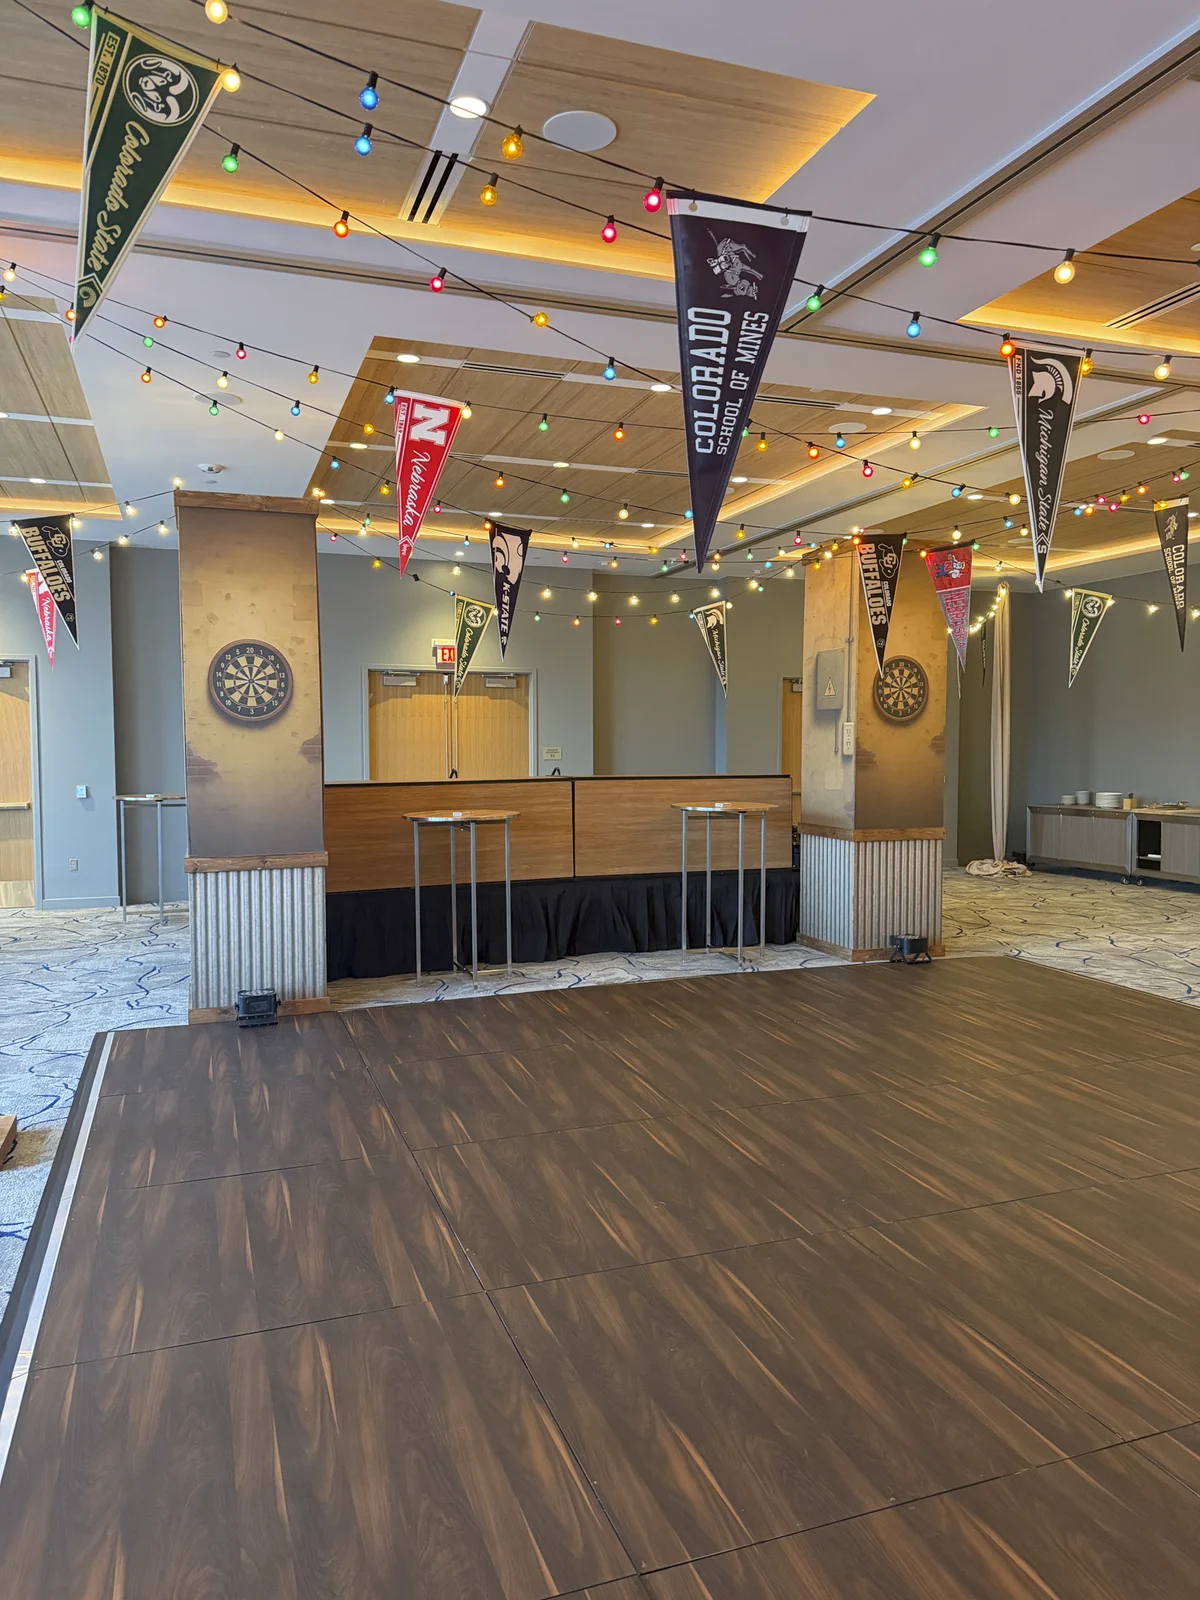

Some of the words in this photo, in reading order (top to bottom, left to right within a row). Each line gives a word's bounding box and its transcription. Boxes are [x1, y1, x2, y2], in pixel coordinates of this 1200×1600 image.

[102, 34, 118, 57] EST.
[95, 62, 110, 86] 1870
[105, 121, 150, 212] Colorado
[87, 210, 122, 272] State
[735, 310, 770, 364] MINES
[687, 306, 732, 454] COLORADO
[730, 370, 750, 391] OF
[410, 402, 450, 447] N
[716, 398, 742, 456] SCHOOL
[1035, 408, 1054, 486] Michigan
[403, 450, 431, 526] Nebraska
[1038, 488, 1051, 531] State
[20, 526, 70, 602] BUFFALOES
[56, 560, 72, 584] COLORADO
[1164, 548, 1173, 574] SCHOOL
[1172, 544, 1185, 608] COLORADO
[858, 544, 888, 625] BUFFALOES
[884, 581, 892, 607] COLORADO
[42, 596, 54, 641] Nebraska
[501, 582, 510, 634] K-STATE
[942, 592, 966, 648] NEBRASKA
[442, 647, 456, 662] EXI
[462, 627, 474, 658] Colorado
[712, 628, 721, 659] Michigan
[1077, 618, 1090, 647] Colorado
